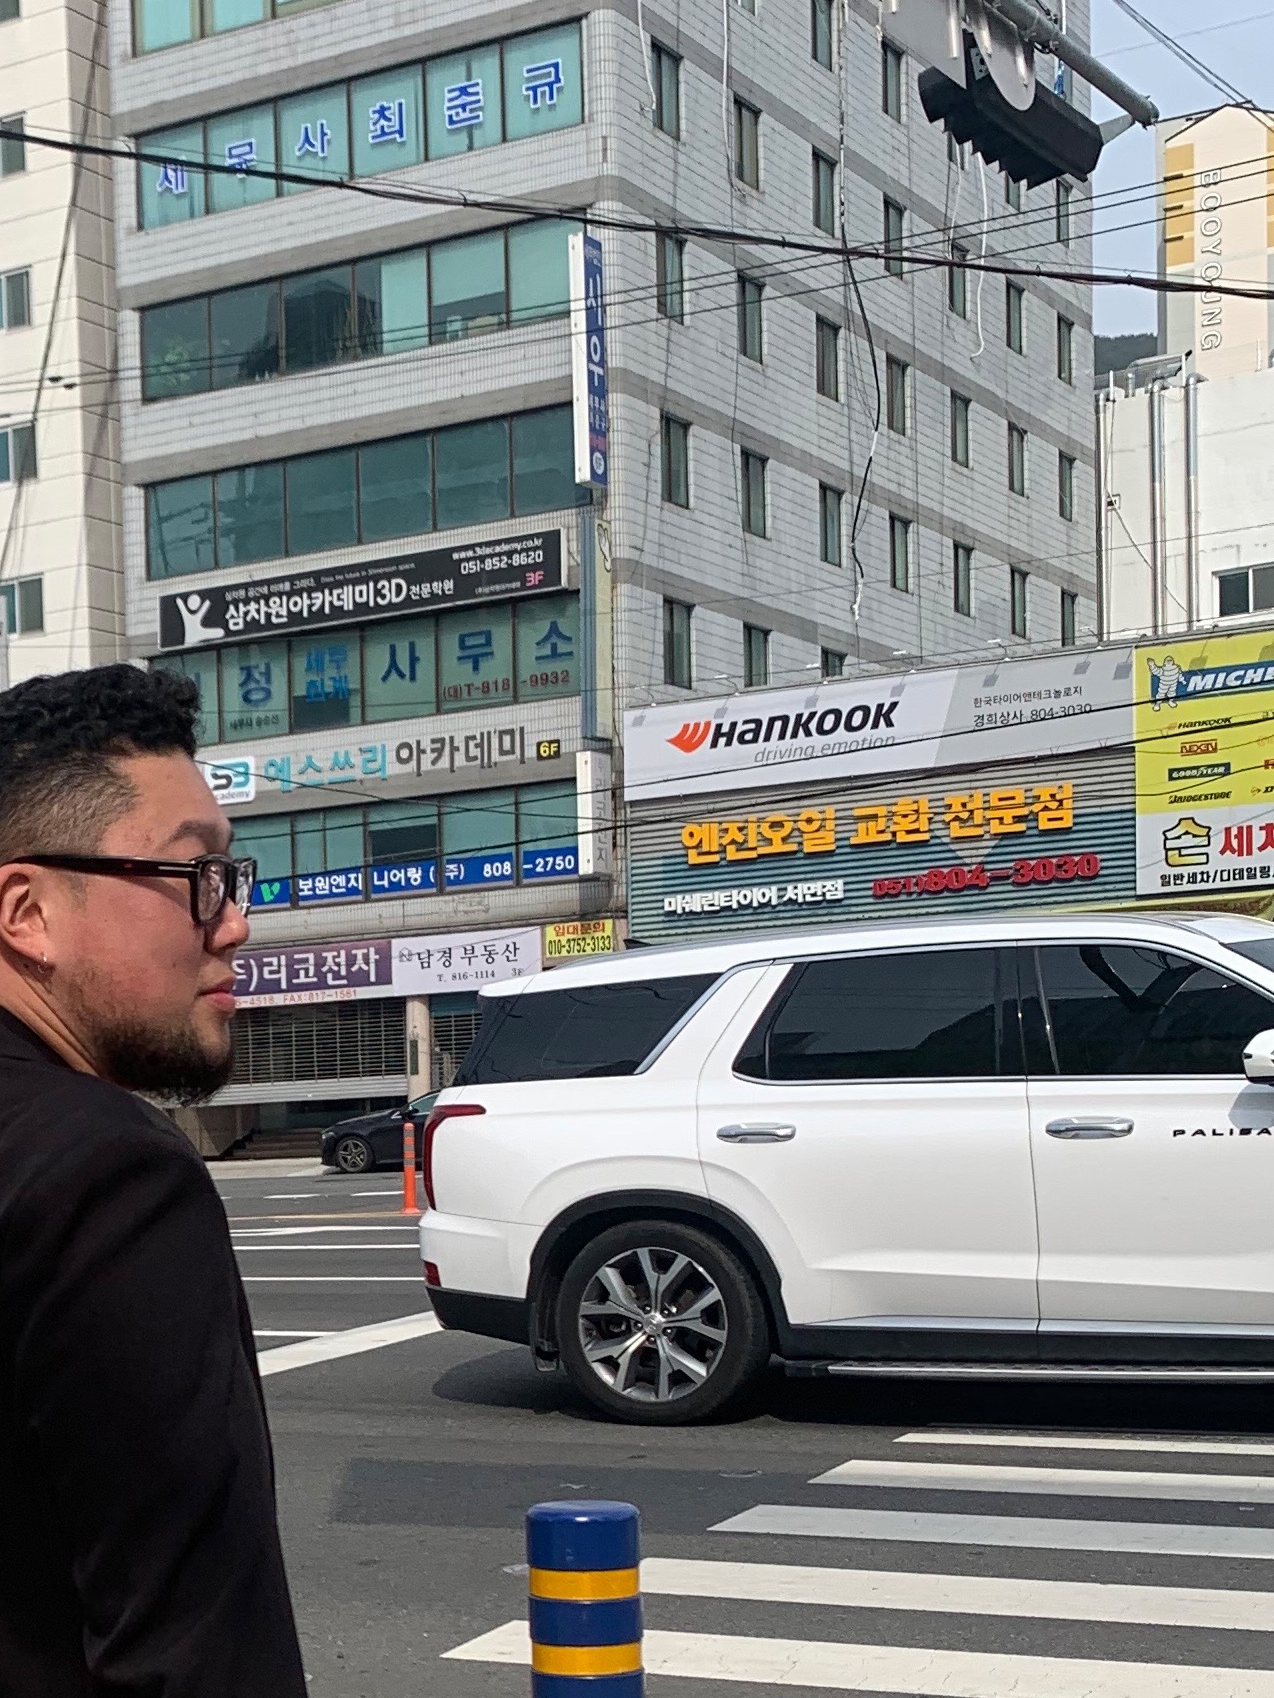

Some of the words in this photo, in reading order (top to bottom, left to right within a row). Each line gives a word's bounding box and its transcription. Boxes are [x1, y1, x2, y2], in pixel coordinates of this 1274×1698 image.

[409, 578, 454, 600] 전문학원
[525, 571, 544, 587] 3F
[973, 709, 1024, 728] 경희상사
[395, 726, 527, 778] 아카데미
[539, 741, 560, 757] 6F
[681, 805, 838, 866] 엔진오일
[849, 796, 935, 845] 교환
[943, 781, 1076, 839] 전문점
[416, 947, 452, 970] 남경
[460, 941, 520, 965] 부동산
